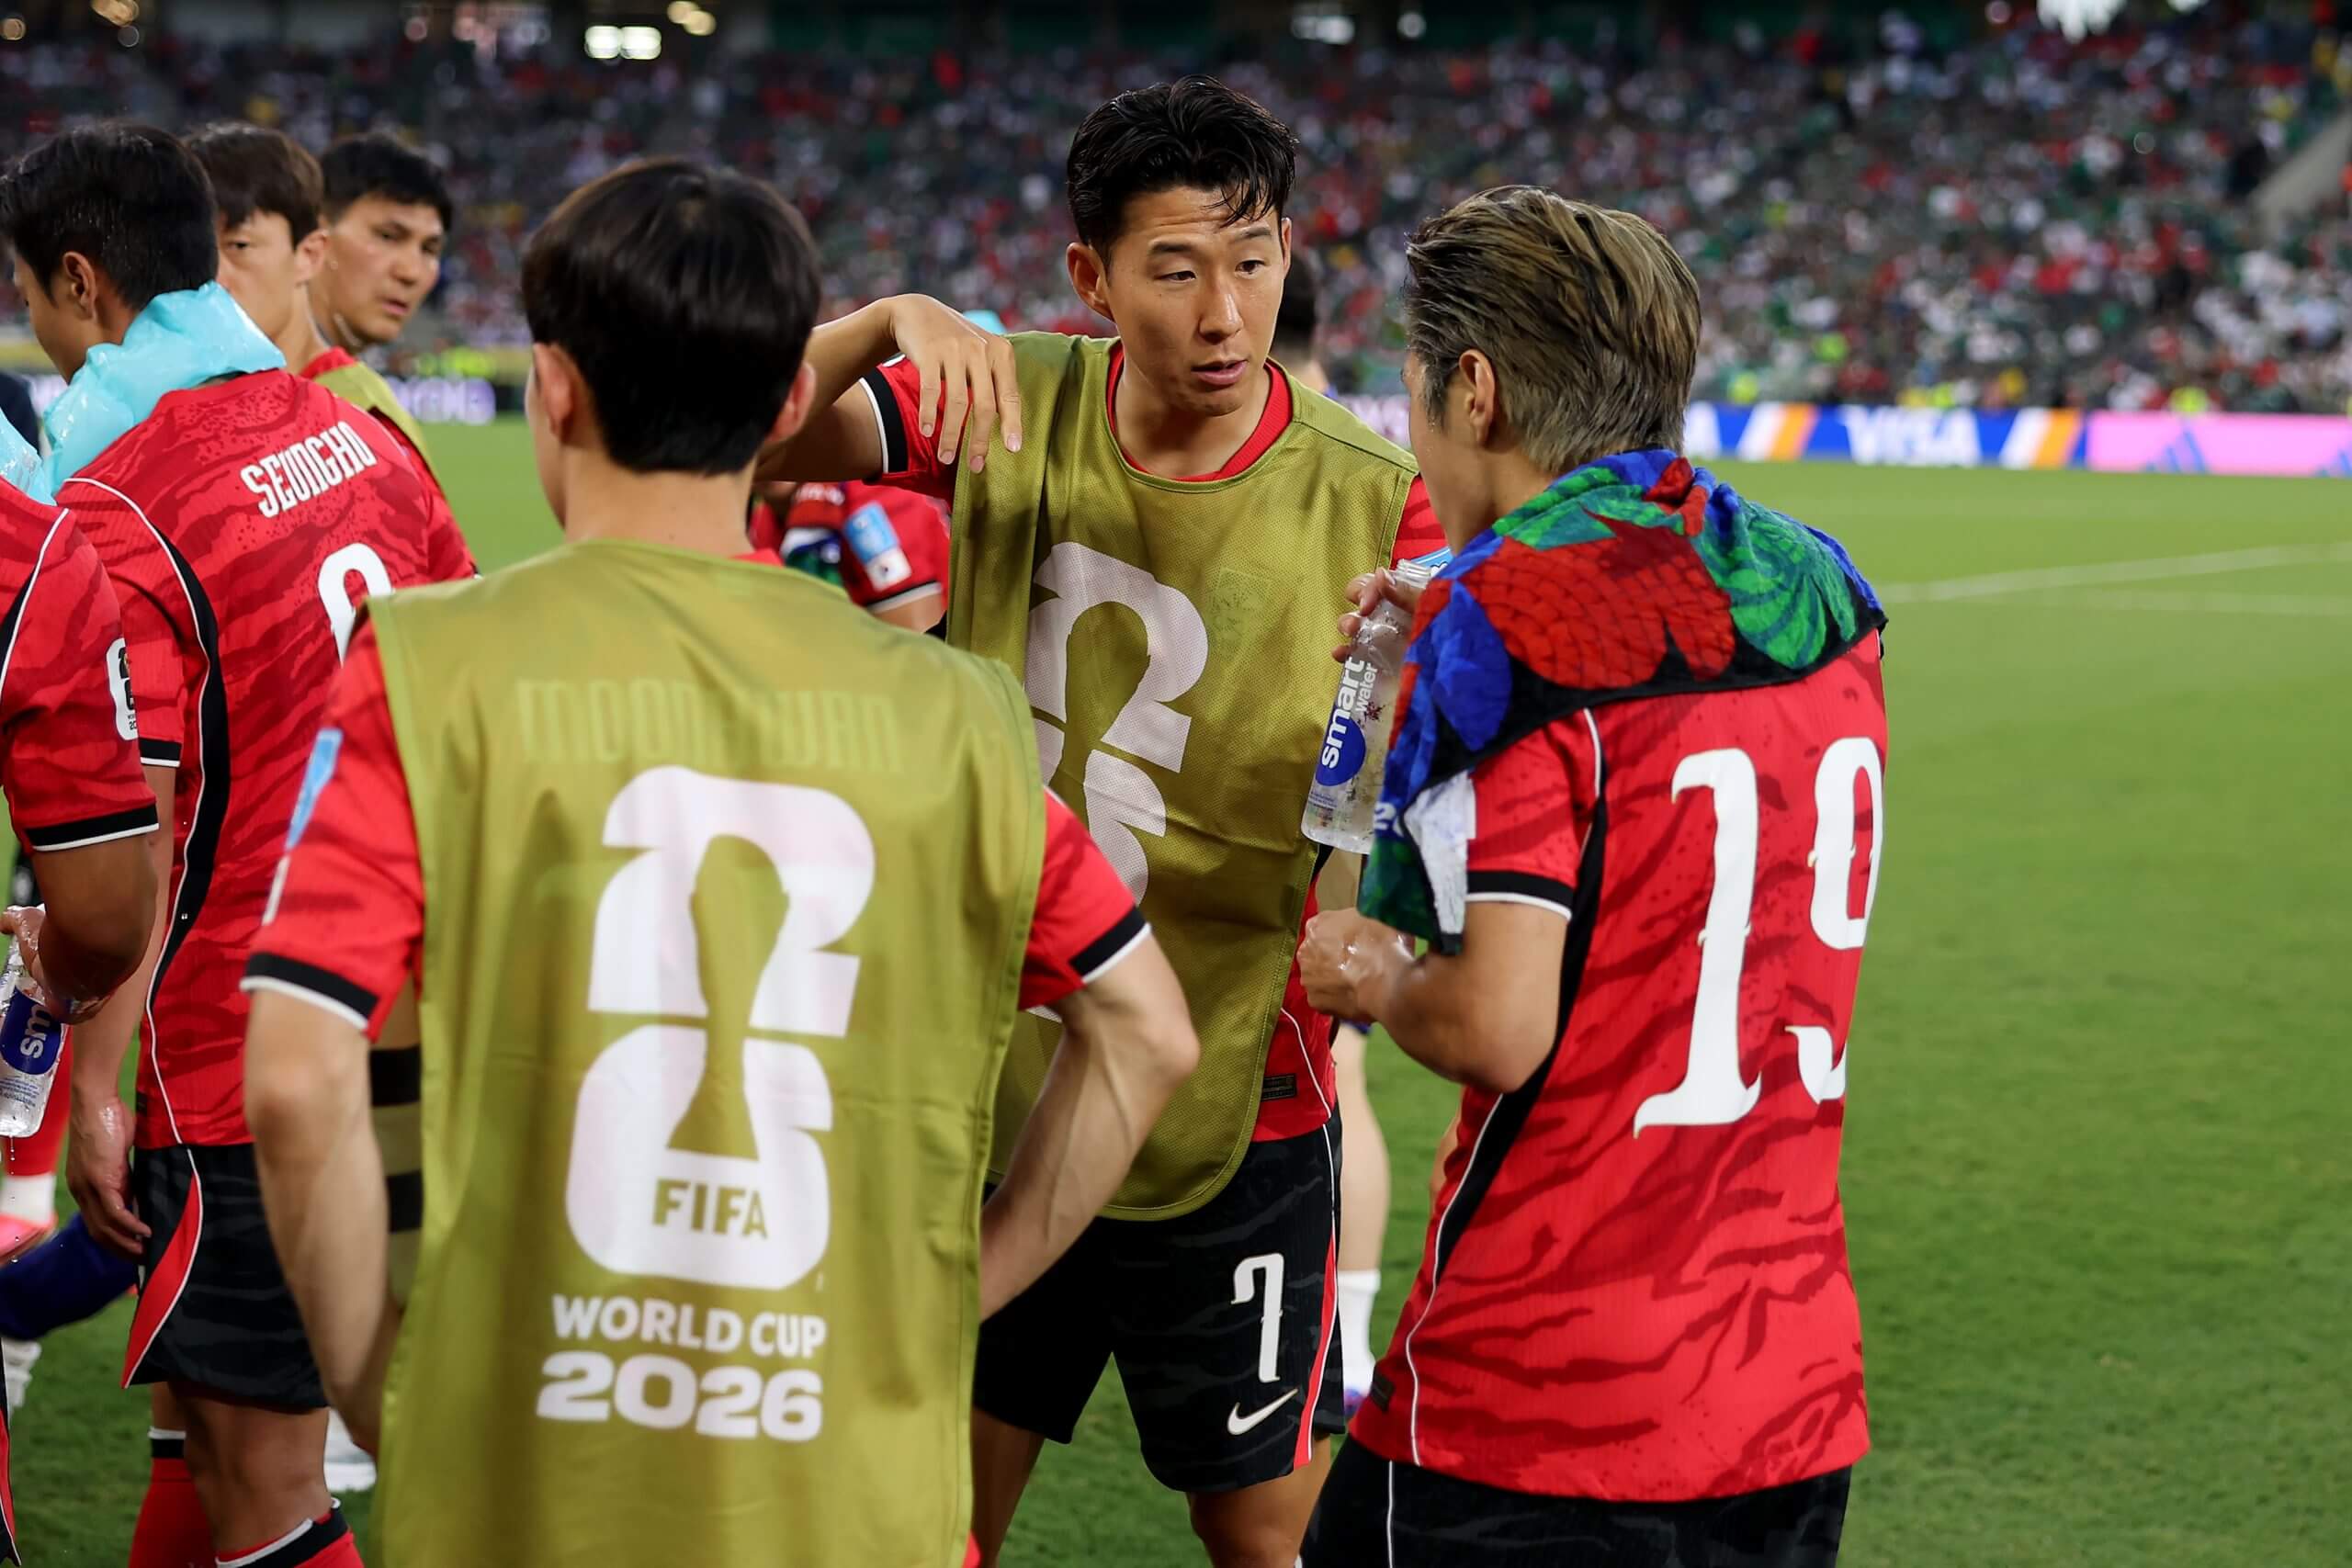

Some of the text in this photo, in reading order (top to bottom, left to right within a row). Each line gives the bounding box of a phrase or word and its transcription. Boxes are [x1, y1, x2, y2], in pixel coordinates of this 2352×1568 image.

[240, 420, 378, 518] SEUNGHO
[1321, 656, 1365, 769] smart
[1354, 662, 1378, 713] water
[1633, 737, 1884, 1139] 19
[652, 1177, 768, 1240] FIFA
[551, 1293, 827, 1359] WORLD CUP
[1230, 1253, 1285, 1383] 7
[536, 1349, 823, 1442] 2026
